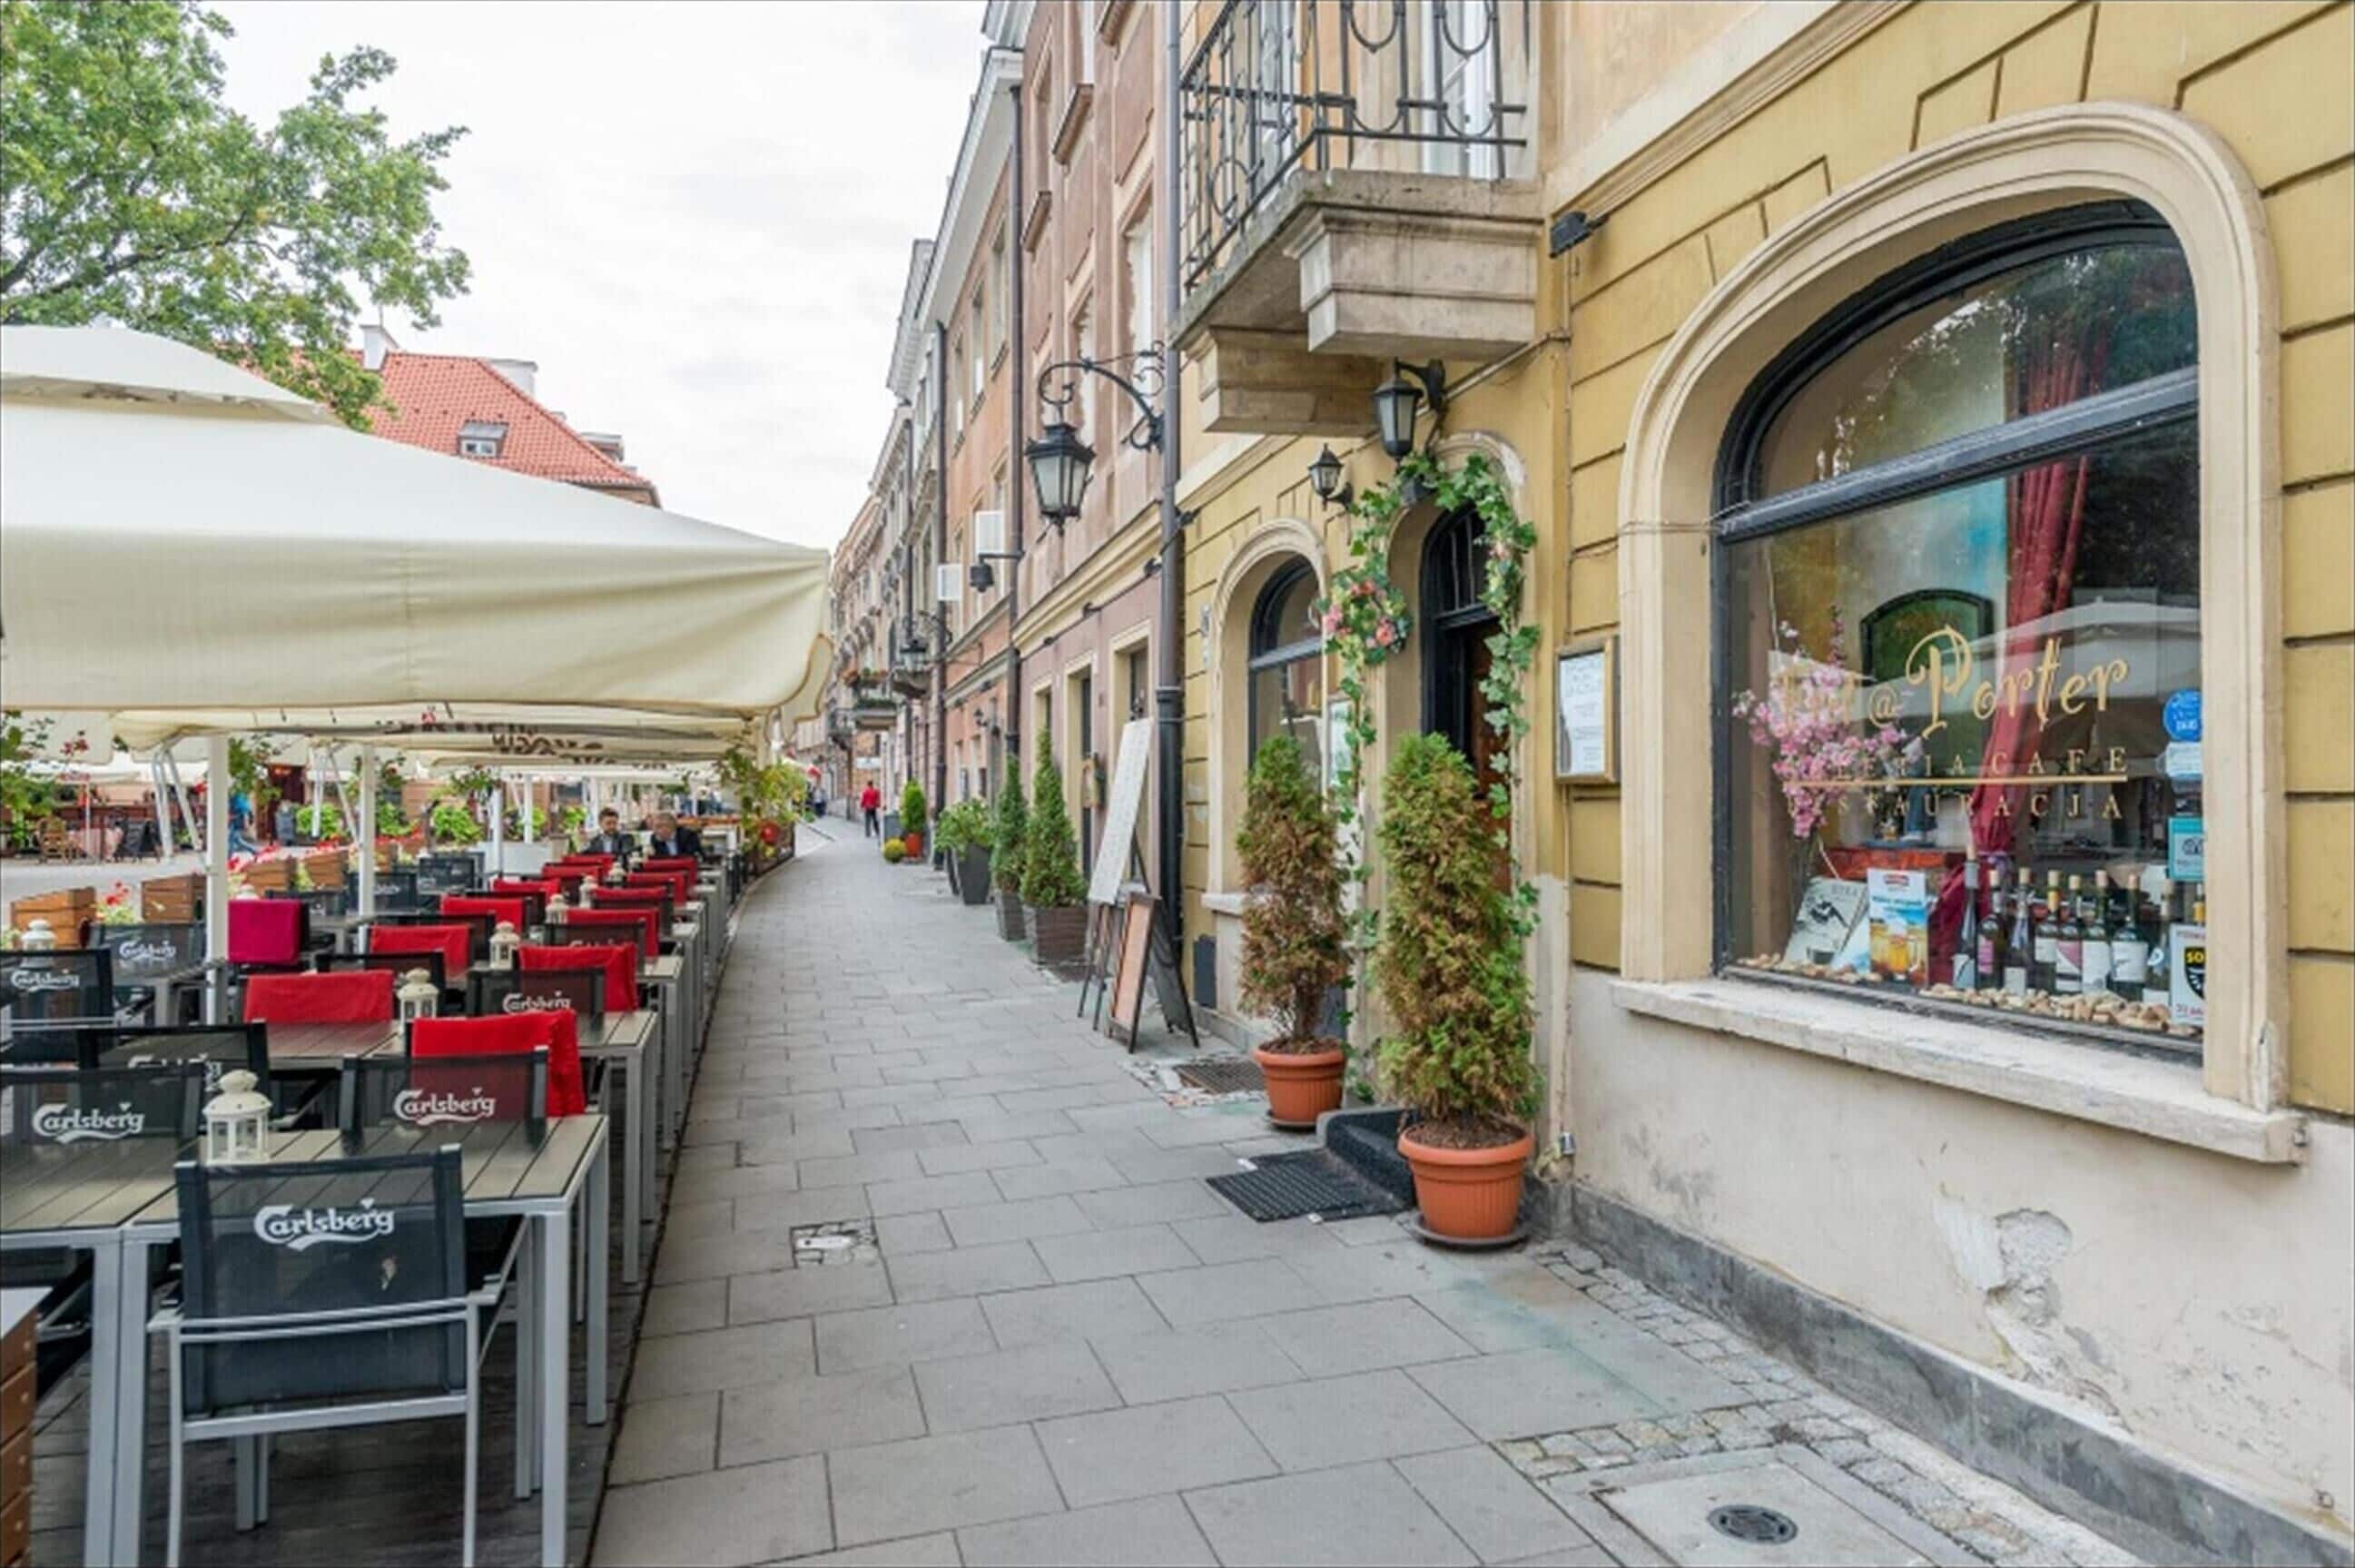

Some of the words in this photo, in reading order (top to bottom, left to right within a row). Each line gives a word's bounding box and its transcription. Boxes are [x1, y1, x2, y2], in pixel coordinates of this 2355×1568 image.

[1905, 624, 2129, 740] Porter
[1992, 747, 2128, 774] CAFE
[11, 968, 80, 992] Carlsberg
[32, 1101, 146, 1144] Carlsberg
[393, 1087, 497, 1127] Carlsberg
[253, 1197, 396, 1252] Carlsberg
